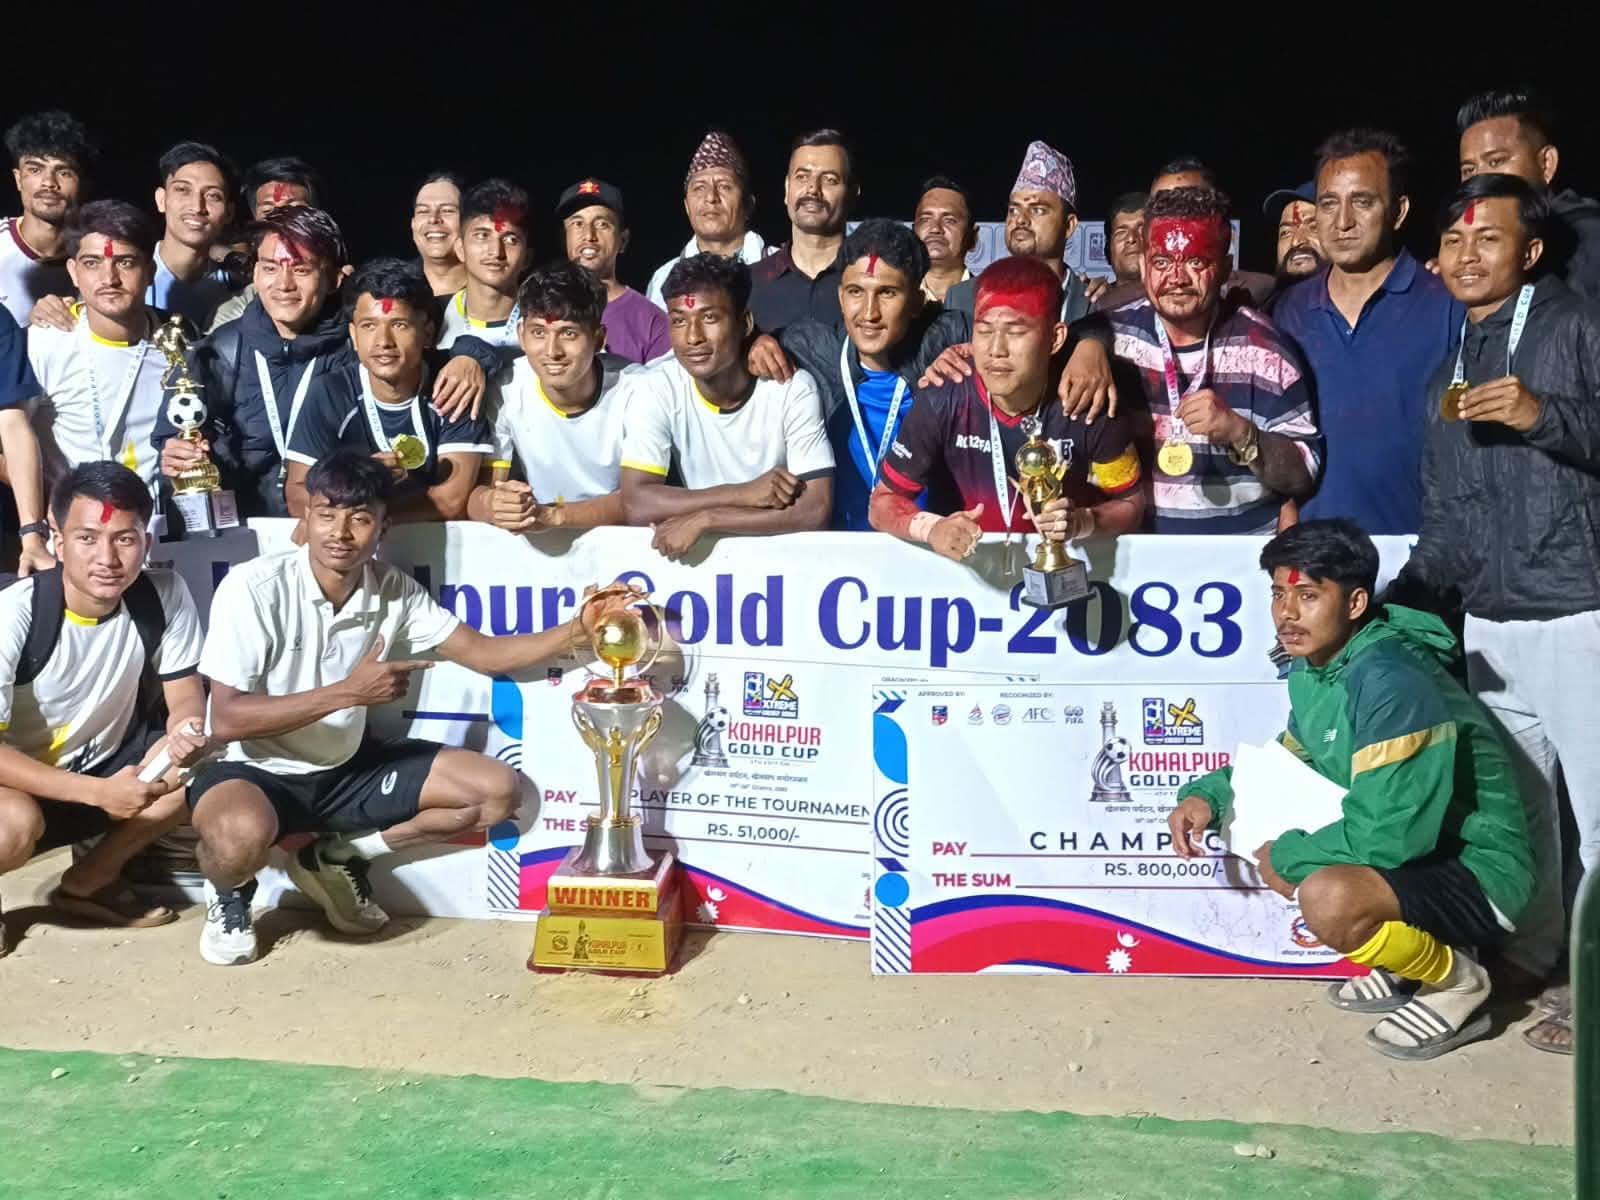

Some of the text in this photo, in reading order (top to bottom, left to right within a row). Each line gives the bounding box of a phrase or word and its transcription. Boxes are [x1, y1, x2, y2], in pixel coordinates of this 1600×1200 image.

[728, 721, 821, 746] KOHALPUR
[728, 743, 819, 759] GOLD CUP
[1129, 752, 1231, 772] KOHALPUR
[1130, 775, 1179, 786] GOLD
[544, 790, 577, 803] PAY
[697, 793, 721, 806] OF
[724, 795, 757, 809] THE
[762, 797, 870, 817] TOURNAMEN
[543, 818, 576, 832] THE
[707, 823, 800, 842] RS. 51,000/-
[932, 842, 967, 856] PAY
[1104, 862, 1224, 878] RS. 800,000/-
[932, 873, 1011, 888] THE SUM
[554, 887, 650, 908] WINNER
